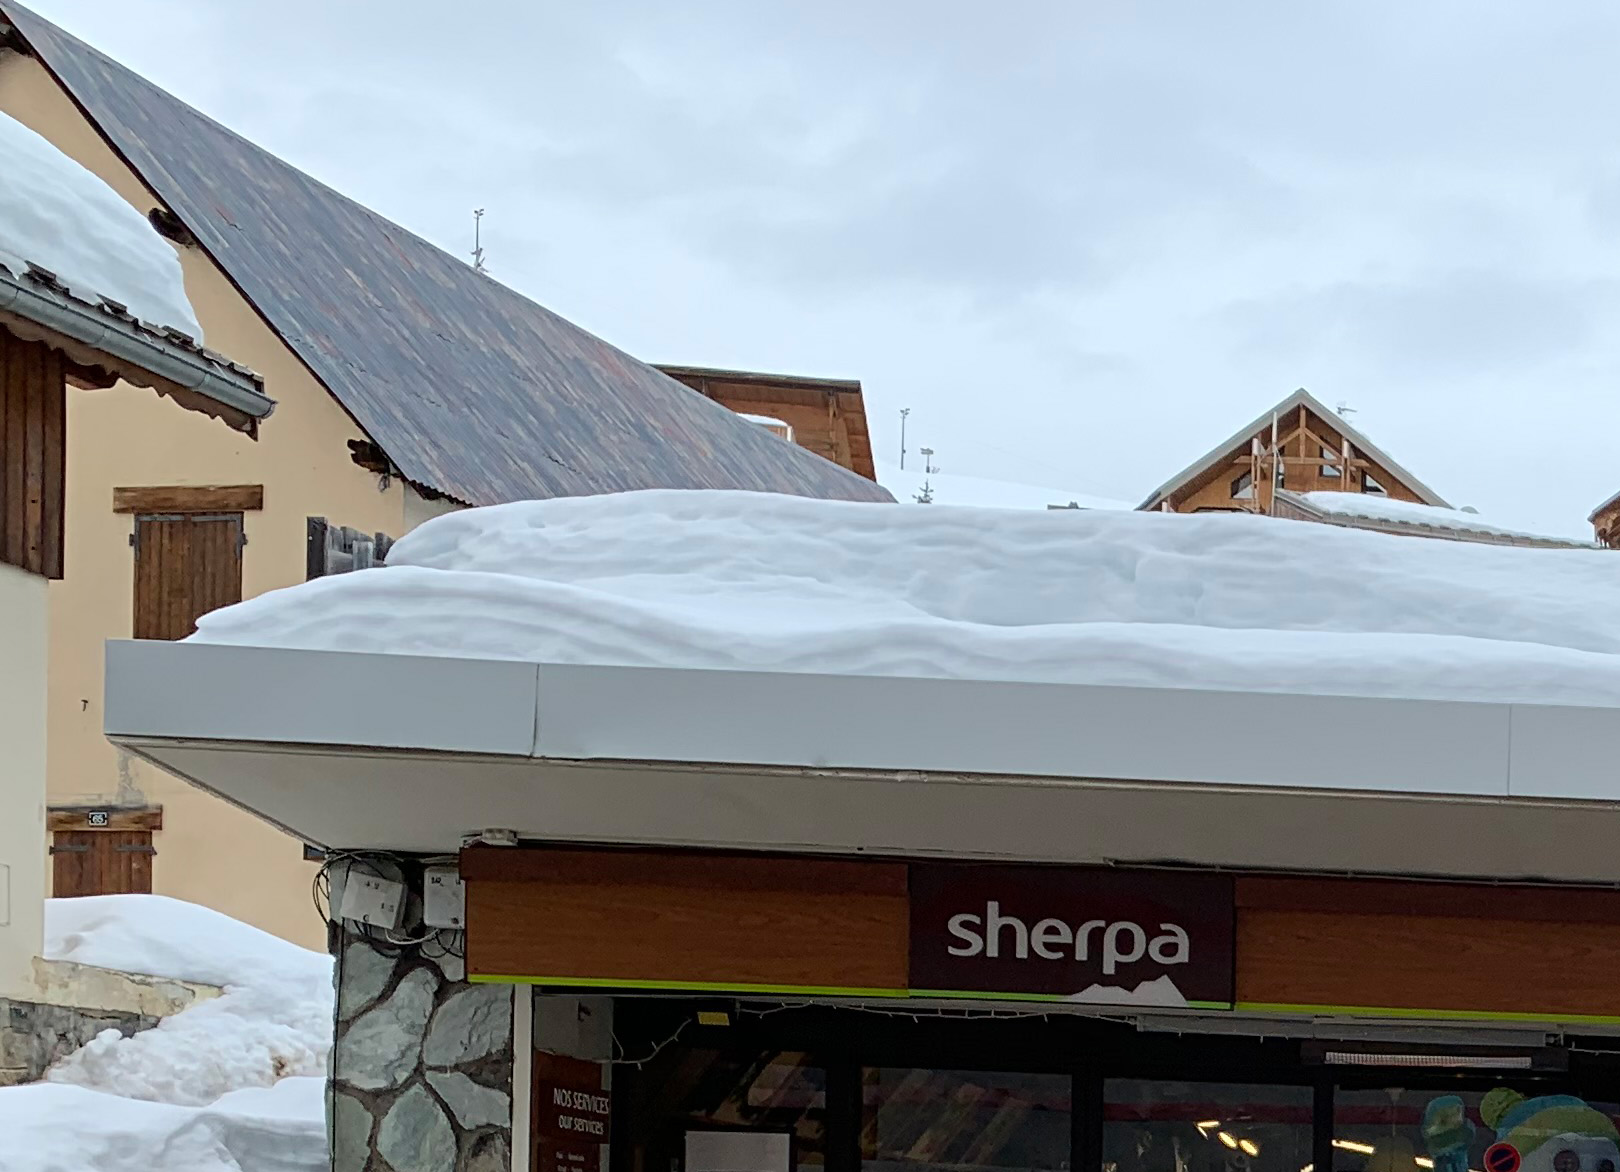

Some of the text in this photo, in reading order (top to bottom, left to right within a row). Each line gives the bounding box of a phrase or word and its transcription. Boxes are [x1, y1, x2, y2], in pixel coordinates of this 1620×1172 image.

[947, 900, 1190, 975] sherpa
[553, 1087, 609, 1115] NOS SERVICES
[558, 1114, 604, 1135] our services
